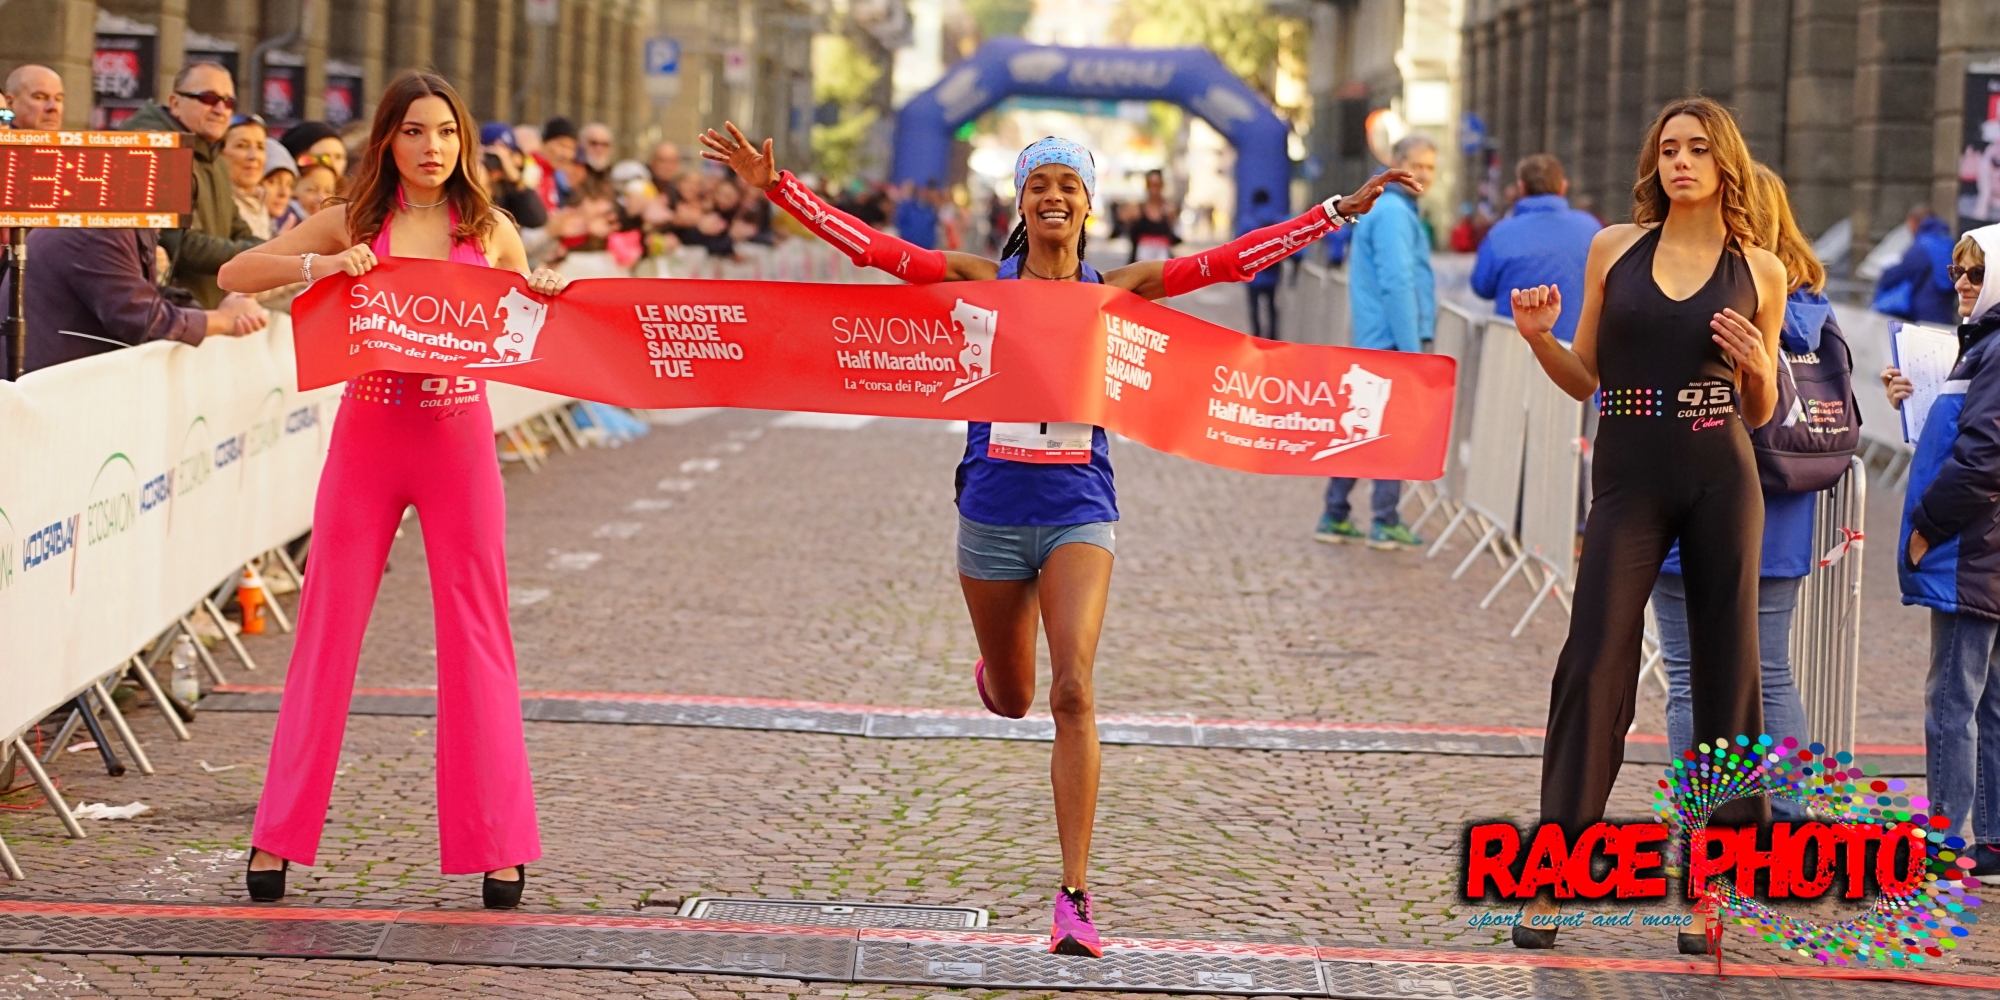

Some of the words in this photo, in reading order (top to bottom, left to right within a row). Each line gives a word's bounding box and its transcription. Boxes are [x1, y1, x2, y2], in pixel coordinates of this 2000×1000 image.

[0, 132, 51, 145] tds.sport
[57, 132, 83, 146] TDS
[88, 132, 139, 146] tds.sport
[147, 133, 173, 147] TDS
[5, 149, 158, 208] 13:47
[56, 214, 82, 228] TDS
[87, 215, 138, 229] tds.sport
[145, 215, 172, 228] TDS
[351, 284, 490, 331] SAVONA
[634, 304, 662, 322] LE
[663, 304, 748, 323] NOSTRE
[349, 313, 387, 335] Half
[387, 319, 487, 353] Marathon
[641, 322, 721, 341] STRADE
[832, 316, 954, 345] SAVONA
[1105, 313, 1121, 337] LE
[1122, 319, 1170, 354] NOSTRE
[349, 343, 360, 355] La
[362, 338, 403, 353] "corsa
[405, 347, 427, 359] dei
[429, 351, 467, 363] Papi"
[646, 340, 744, 360] SARANNO
[1106, 334, 1147, 368] STRADE
[649, 359, 695, 378] TUE
[836, 350, 871, 370] Half
[873, 351, 957, 372] Marathon
[1105, 355, 1152, 391] SARANNO
[421, 375, 477, 395] 9.5
[844, 377, 857, 390] La
[858, 378, 893, 392] "corsa
[894, 379, 912, 393] dei
[914, 380, 943, 397] Papi"
[1104, 375, 1122, 402] TUE
[1212, 365, 1337, 408] SAVONA
[420, 398, 452, 408] COLD
[454, 393, 481, 405] WINE
[1677, 386, 1731, 406] 9.5
[1808, 399, 1843, 408] Gruppo
[1207, 397, 1240, 422] Half
[1238, 405, 1336, 432] Marathon
[1677, 408, 1707, 418] COLD
[1709, 405, 1734, 416] WINE
[1810, 406, 1843, 415] Giudici
[1692, 417, 1725, 431] Colors
[1206, 426, 1219, 440] La
[1253, 436, 1277, 450] dei
